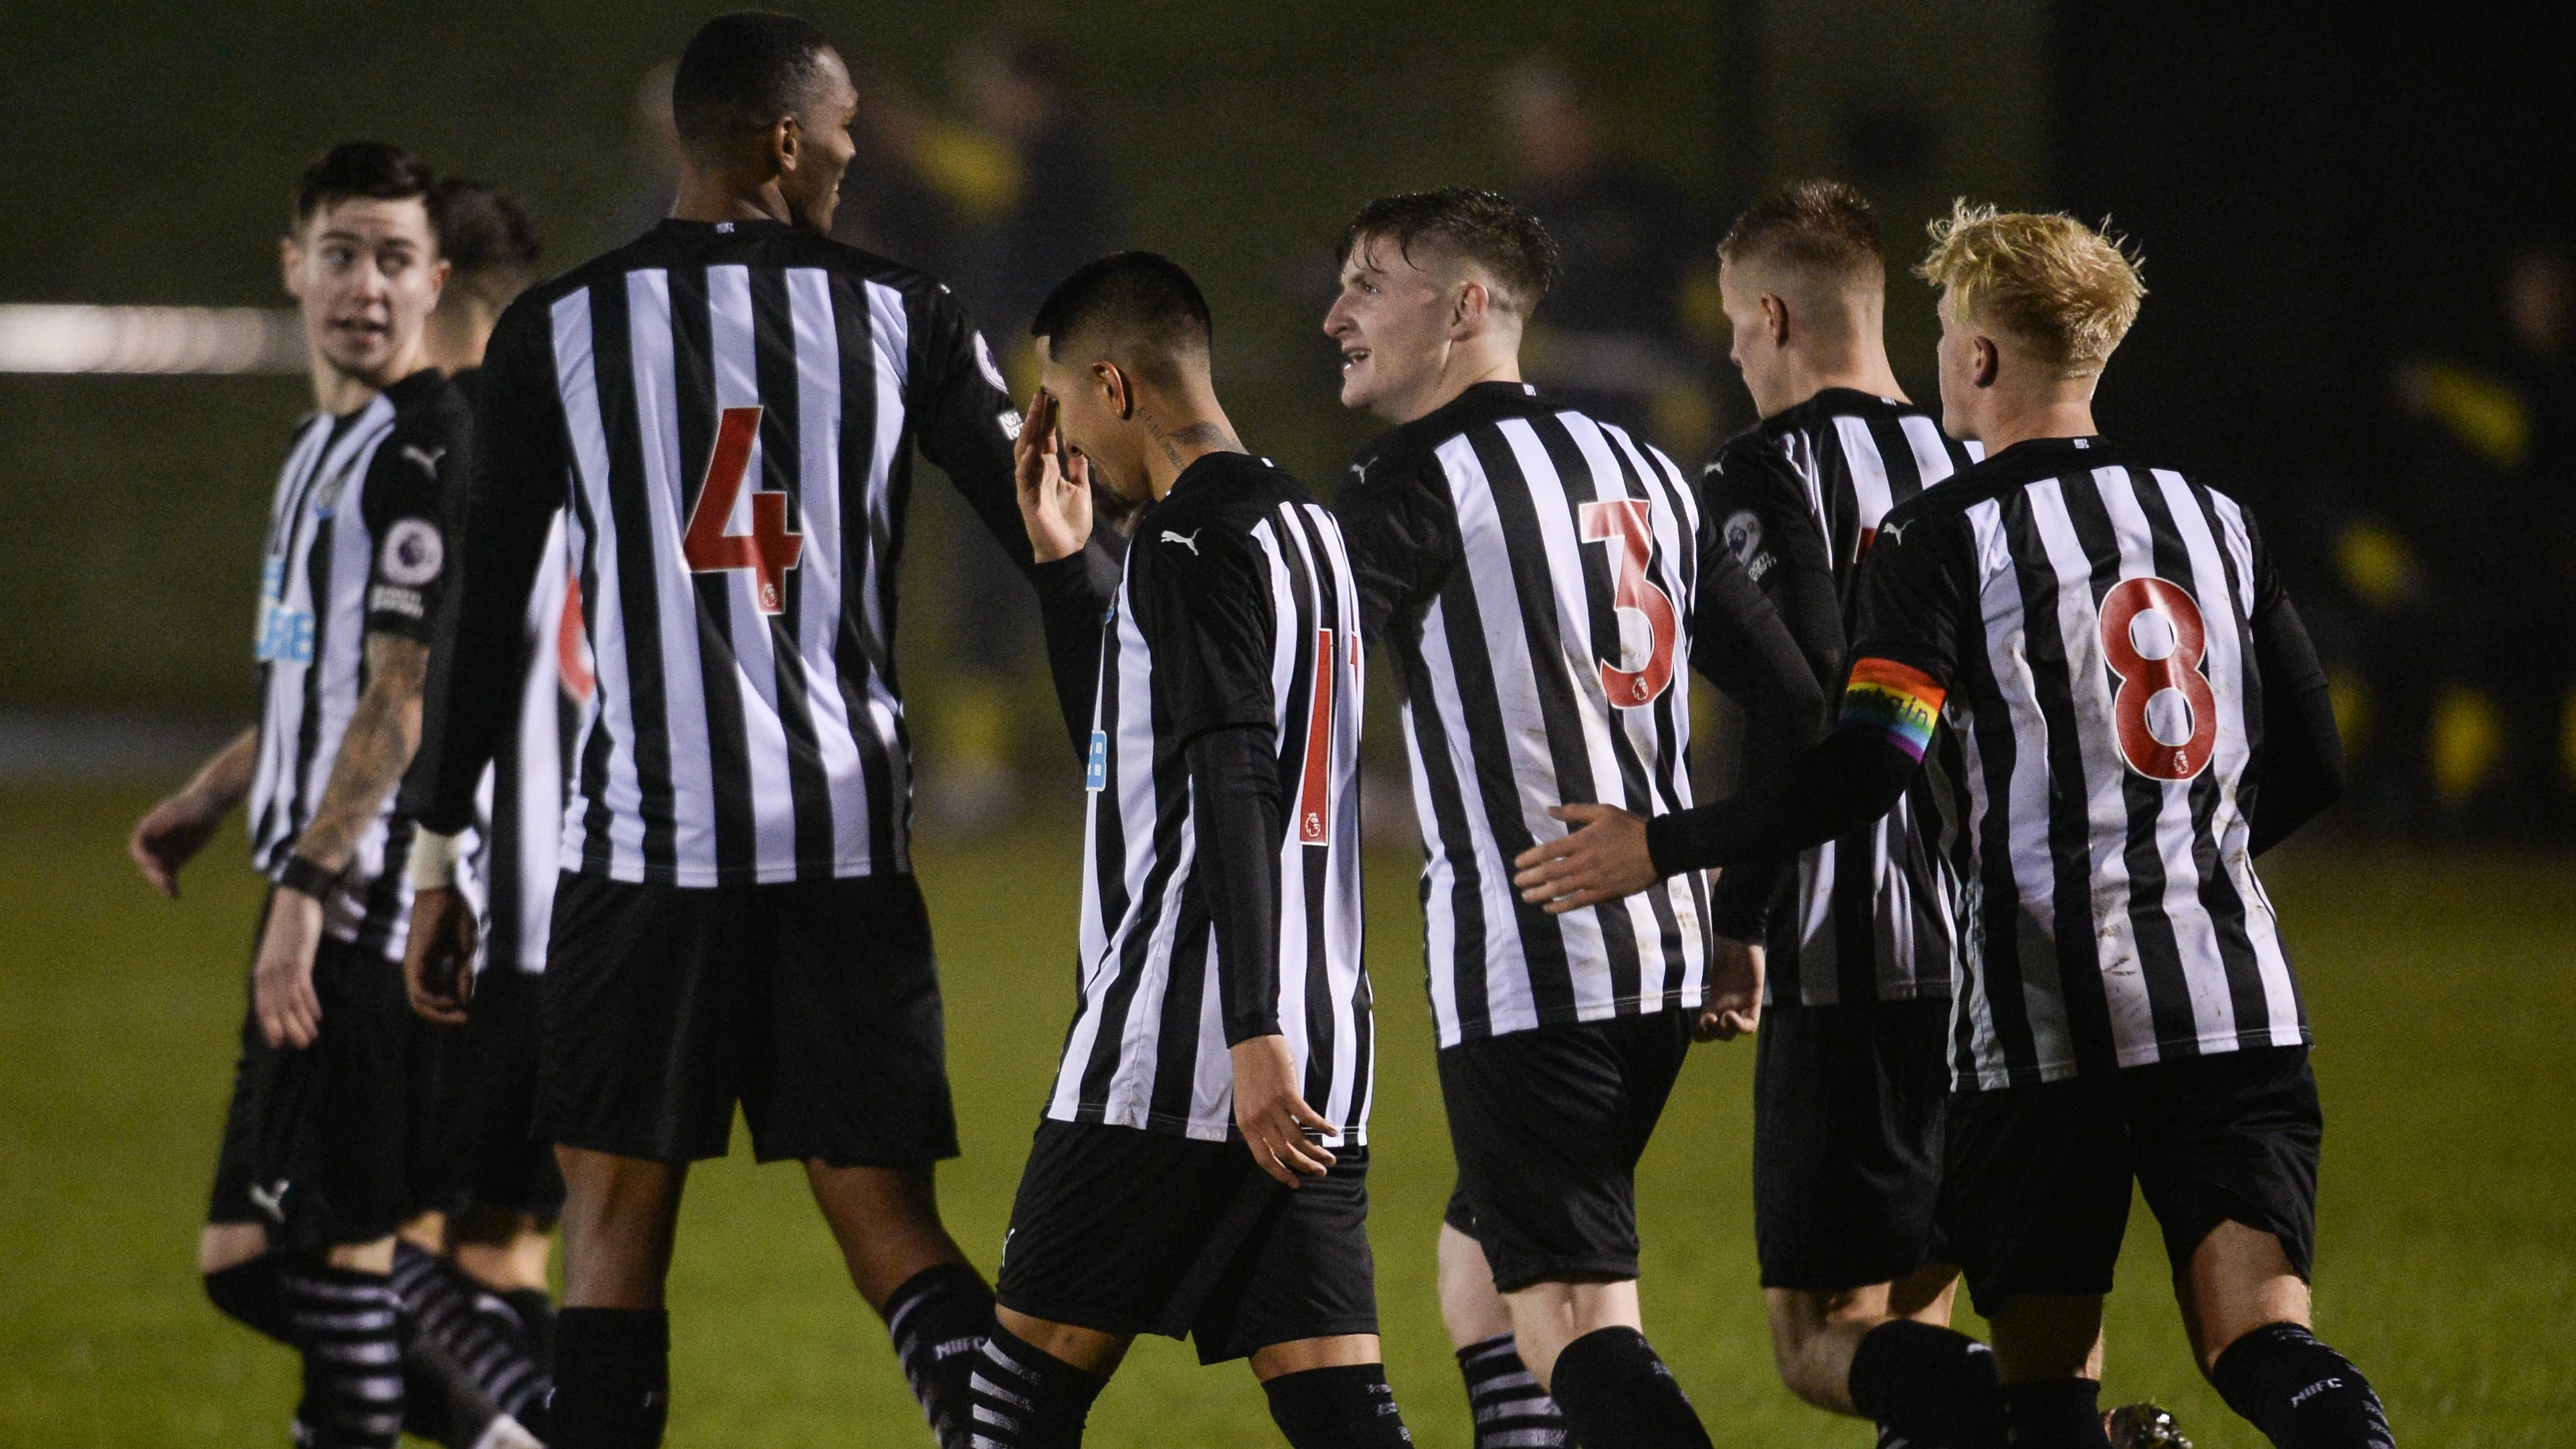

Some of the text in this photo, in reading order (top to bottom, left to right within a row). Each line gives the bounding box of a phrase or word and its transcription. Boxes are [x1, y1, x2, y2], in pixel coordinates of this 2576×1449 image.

[680, 405, 804, 615] 4
[1579, 498, 1676, 710] 3
[2098, 576, 2218, 781] 8
[2290, 1377, 2344, 1408] NUFC
